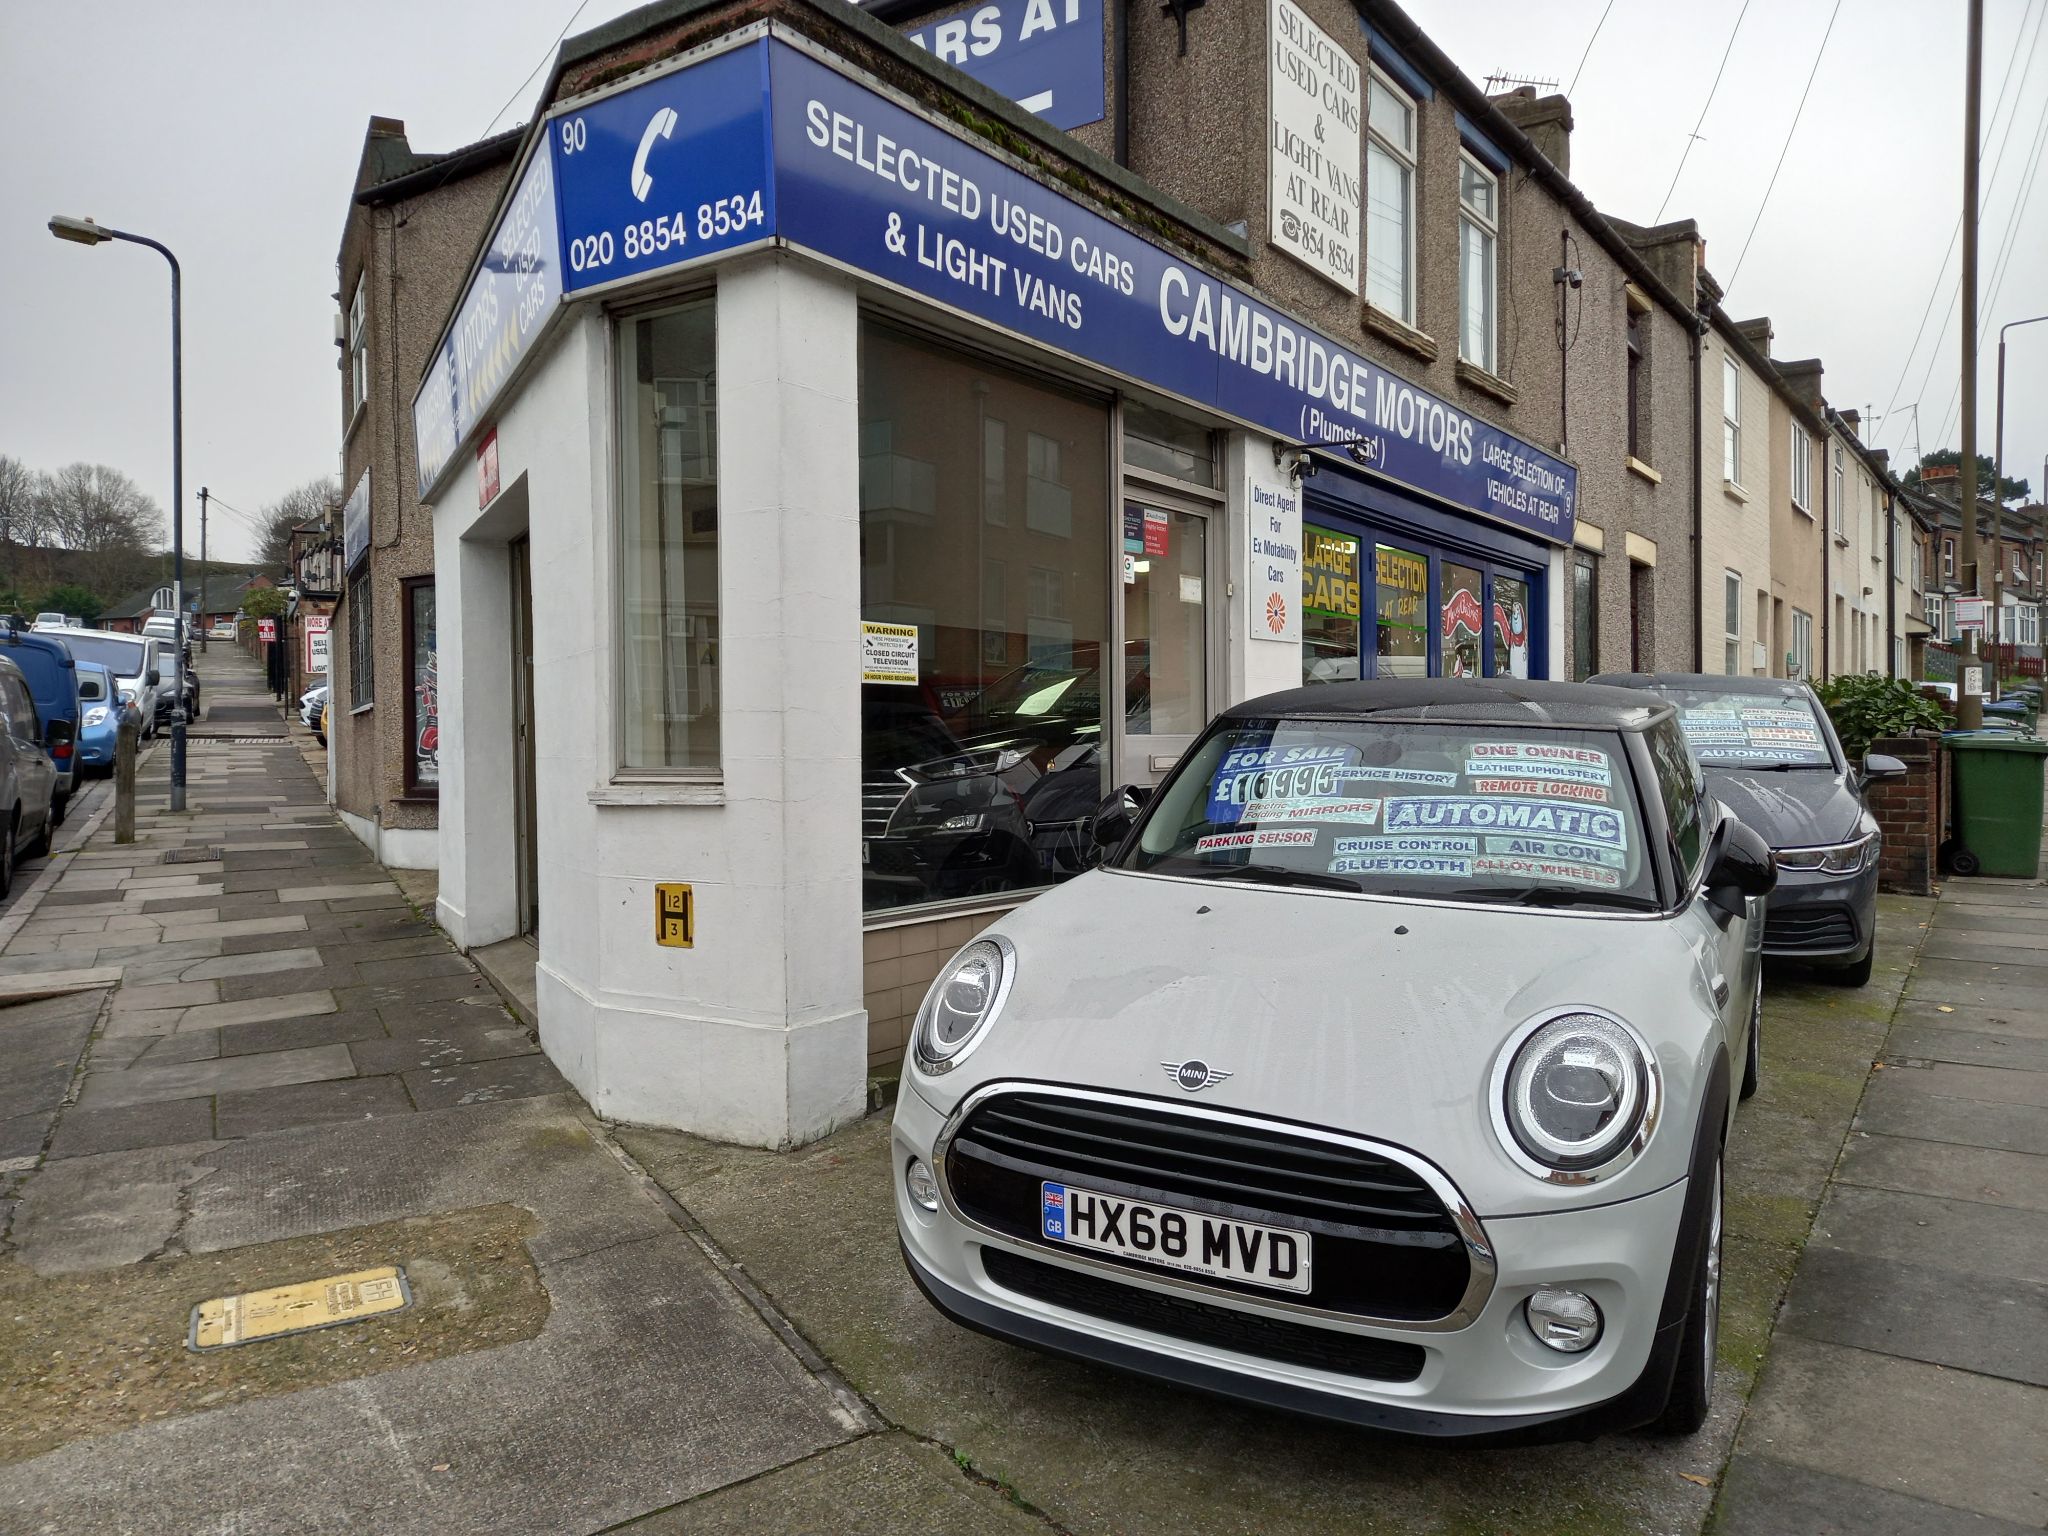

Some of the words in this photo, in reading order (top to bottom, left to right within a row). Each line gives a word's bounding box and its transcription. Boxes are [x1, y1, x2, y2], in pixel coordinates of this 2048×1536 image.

[909, 5, 1002, 65] RS
[1279, 4, 1355, 94] SELECTED
[1276, 39, 1318, 98] USED
[1322, 82, 1358, 134] CARS
[562, 117, 587, 155] 90
[1314, 113, 1325, 144] &
[1273, 119, 1322, 180] LIGHT
[1326, 159, 1360, 209] VANS
[806, 99, 981, 220] SELECTED
[991, 193, 1063, 260] USED
[1070, 236, 1135, 296] CARS
[1286, 171, 1307, 207] AT
[1311, 185, 1349, 239] REAR
[502, 156, 548, 270] SELECTED
[570, 231, 614, 272] 020
[624, 212, 687, 259] 8854
[697, 190, 764, 240] 8534
[515, 225, 541, 293] USED
[1302, 221, 1324, 260] 854
[1328, 239, 1354, 280] 8534
[884, 212, 907, 257] &
[918, 223, 1007, 297] LIGHT
[1013, 267, 1082, 330] VANS
[519, 270, 545, 335] CARS
[456, 276, 499, 382] MOTORS
[1159, 266, 1368, 419] CAMBRIDGE
[1374, 375, 1473, 466] MOTORS
[1482, 441, 1512, 473] LARGE
[1512, 455, 1555, 491] SELECTION
[1554, 475, 1565, 496] OF
[1254, 485, 1275, 507] Direct
[1277, 493, 1296, 513] Agent
[1487, 477, 1527, 512] VEHICLES
[1527, 495, 1538, 517] AT
[1538, 500, 1559, 525] REAR
[1270, 516, 1281, 533] For
[1253, 537, 1262, 554] Ex
[1263, 539, 1297, 565] Motability
[1303, 532, 1352, 576] LARGE
[1268, 564, 1284, 583] Cars
[1302, 571, 1360, 615] CARS
[1384, 599, 1394, 620] AT
[1398, 596, 1418, 617] REAR
[259, 631, 276, 639] SALE
[307, 617, 322, 628] MORE
[866, 626, 914, 637] WARNING
[865, 649, 890, 657] CLOSED
[873, 658, 909, 666] TELEVISION
[1223, 750, 1277, 770] FOR
[1282, 747, 1347, 762] SALE
[1474, 745, 1519, 756] ONE
[1525, 746, 1603, 764] OWNER
[1700, 749, 1806, 760] AUTOMATIC
[1333, 770, 1391, 778] SERVICE
[1394, 771, 1454, 783] HISTORY
[1469, 764, 1523, 772] LEATHER
[1526, 766, 1607, 781] UPHOLSTERY
[1480, 780, 1539, 792] REMOTE
[1542, 783, 1604, 799] LOCKING
[1288, 803, 1373, 818] MIRRORS
[1391, 803, 1617, 838] AUTOMATIC
[1200, 834, 1254, 848] PARKING
[1257, 832, 1313, 843] SENSOR
[1337, 841, 1393, 851] CRUISE
[1398, 840, 1473, 851] CONTROL
[1509, 840, 1546, 854] AIR
[1553, 844, 1600, 861] CON
[1336, 859, 1465, 872] BLUETOOTH
[1475, 859, 1533, 871] ALLOY
[1540, 863, 1616, 884] WHEELS
[668, 895, 680, 908] 12
[660, 890, 689, 942] H
[671, 923, 678, 936] 3
[1180, 1068, 1206, 1080] MINI
[1047, 1219, 1062, 1234] GB
[1070, 1193, 1187, 1258] HX68
[1202, 1219, 1298, 1281] MVD
[1122, 1251, 1147, 1260] CAMBRIDGE
[1147, 1256, 1166, 1265] MOTORS
